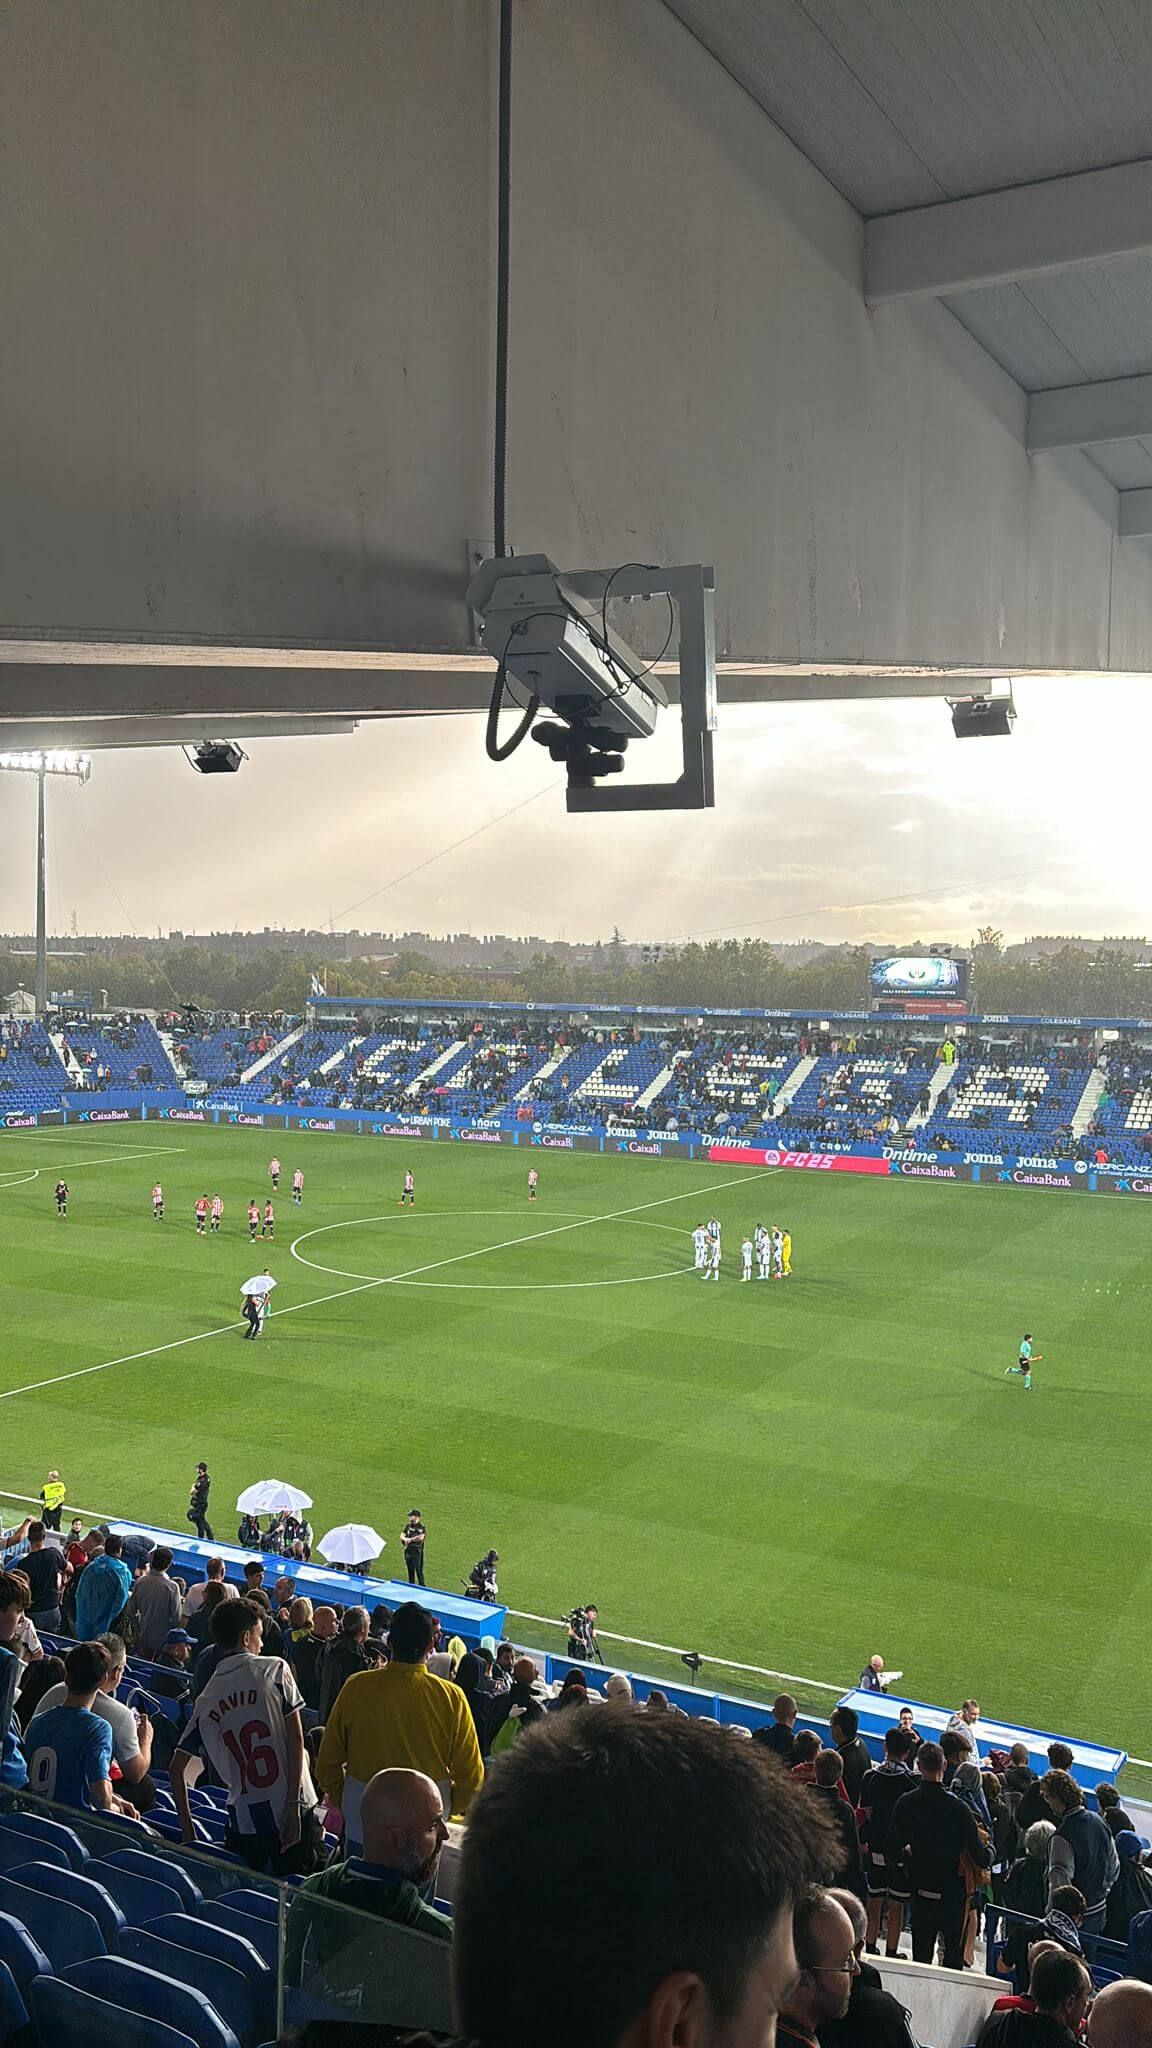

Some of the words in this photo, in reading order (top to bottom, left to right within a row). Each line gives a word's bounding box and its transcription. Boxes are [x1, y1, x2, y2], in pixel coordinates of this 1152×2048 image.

[205, 1100, 240, 1113] CaixaBank
[90, 1110, 129, 1121] CaixaBank
[170, 1109, 205, 1121] CaixaBank
[410, 1115, 433, 1126] URBAN
[433, 1116, 451, 1128] POKE
[383, 1124, 422, 1137] CaixaBank
[543, 1123, 593, 1133] MERCANZA
[461, 1129, 501, 1143] CaixaBank
[701, 1134, 751, 1149] Ontime
[820, 1142, 852, 1151] CROW
[882, 1147, 938, 1163] Ontime
[901, 1162, 956, 1179] CaixaBank
[1013, 1171, 1072, 1187] CaixaBank
[208, 1689, 258, 1723] DAVID
[222, 1719, 279, 1797] 16
